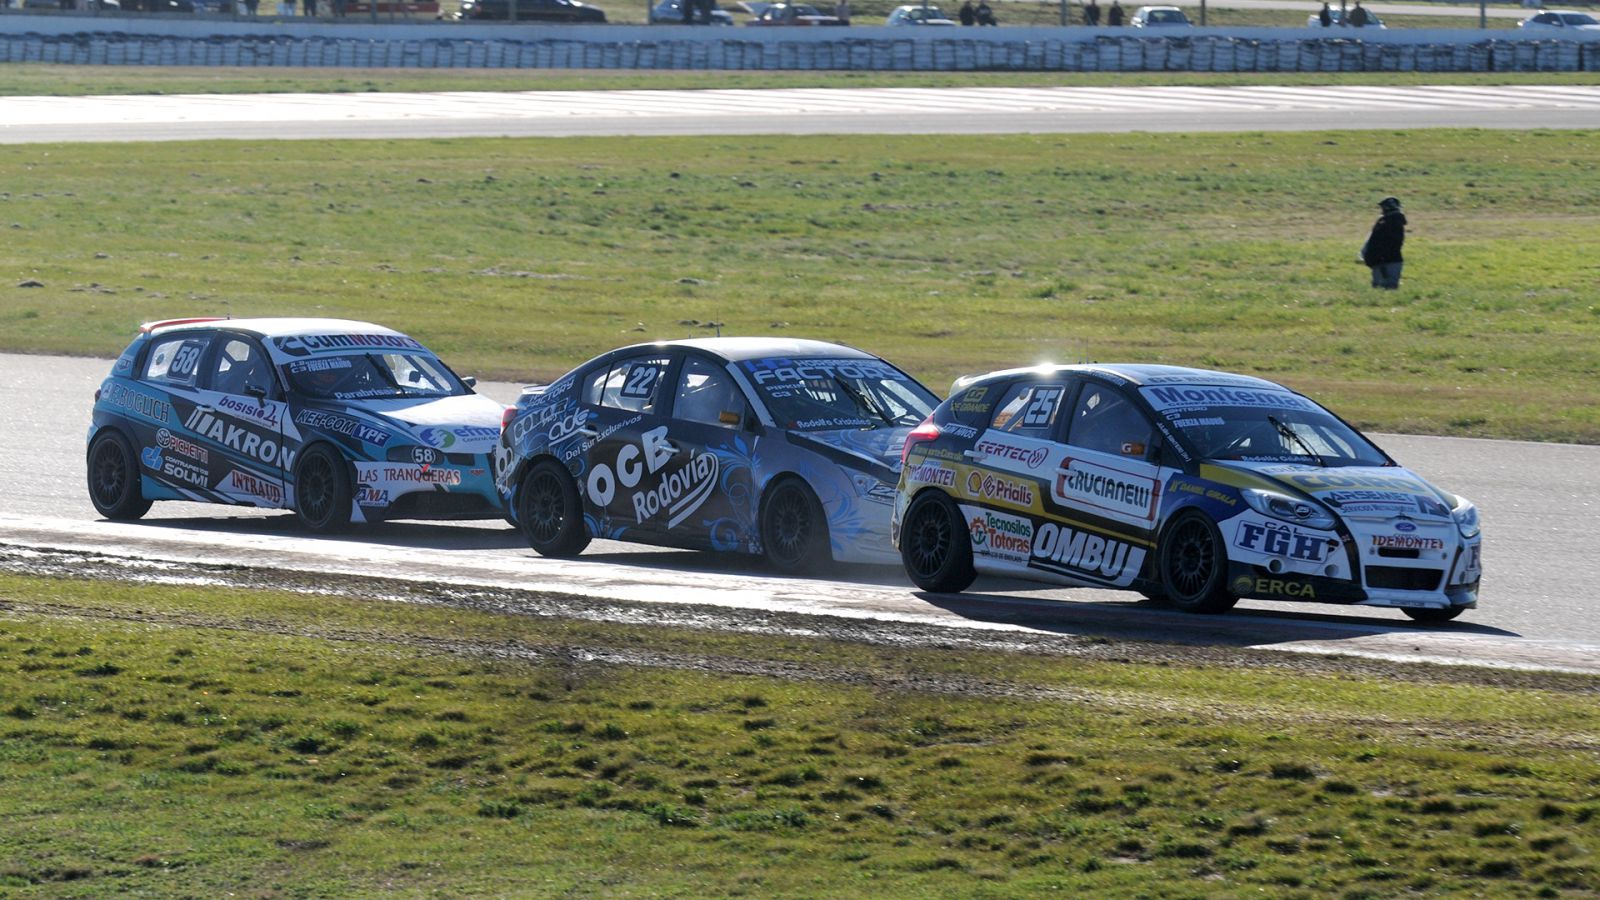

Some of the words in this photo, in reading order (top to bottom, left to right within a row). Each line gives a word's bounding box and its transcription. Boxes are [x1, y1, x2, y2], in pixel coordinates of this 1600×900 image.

[171, 346, 199, 375] 58
[624, 366, 657, 395] 22
[753, 367, 907, 384] FACTORY
[1024, 389, 1060, 424] 25
[359, 425, 387, 443] YPF
[566, 446, 581, 460] Del
[582, 438, 595, 452] Sur
[597, 415, 642, 442] Exclusivos
[415, 448, 432, 463] 58
[587, 425, 672, 507] OCB
[164, 462, 208, 488] SOLMI
[232, 469, 281, 503] INTRAUD
[360, 469, 378, 482] LAS
[632, 448, 709, 525] Rodovía
[996, 480, 1032, 505] Prialis
[985, 512, 1031, 537] Tecnosilos
[1265, 521, 1303, 535] CAL
[988, 528, 1029, 554] Totoras
[1239, 523, 1327, 562] FGH
[1255, 578, 1316, 598] ERCA
